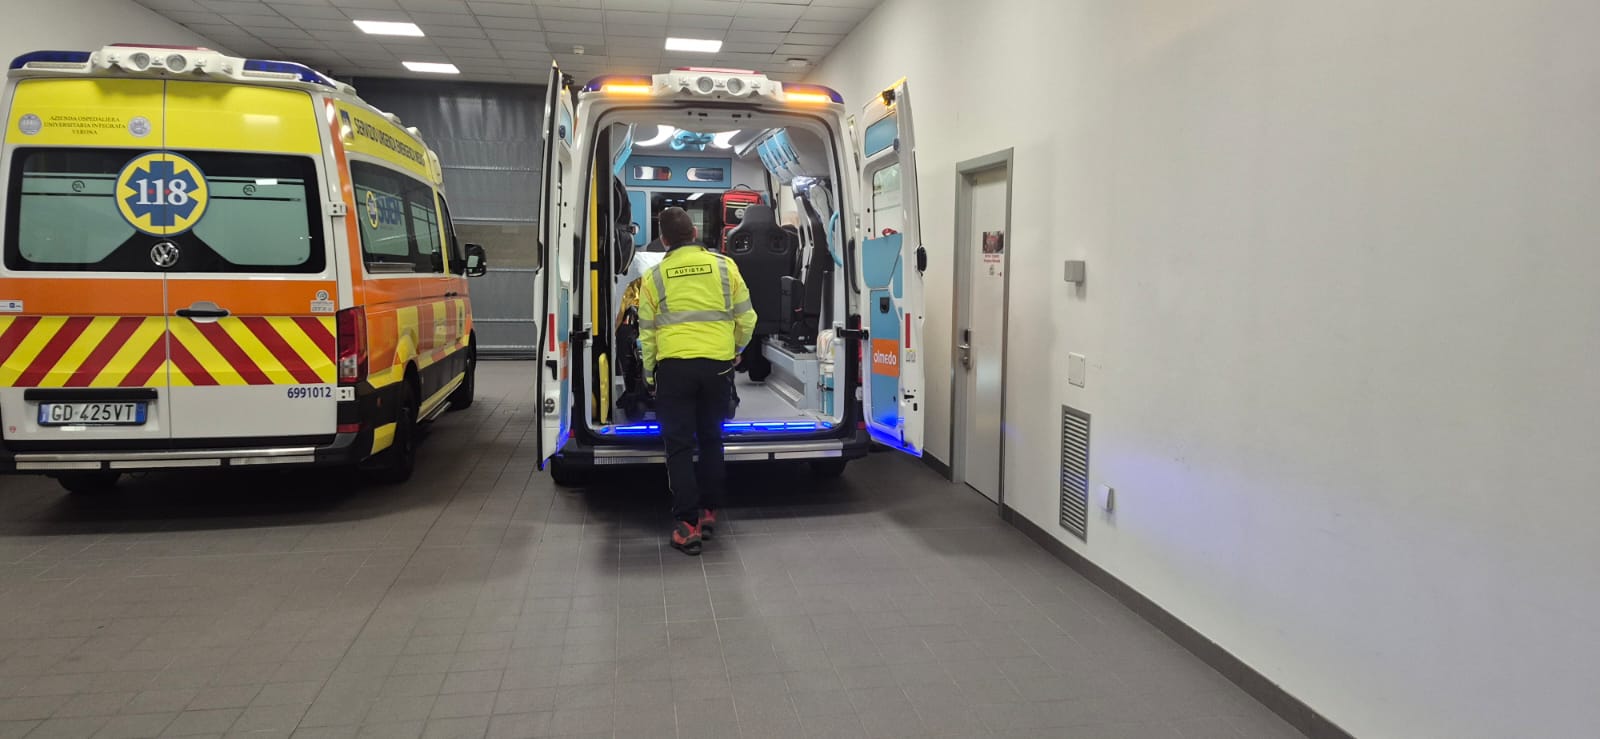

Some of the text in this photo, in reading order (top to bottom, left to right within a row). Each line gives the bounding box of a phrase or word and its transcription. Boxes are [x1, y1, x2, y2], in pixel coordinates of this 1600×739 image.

[354, 117, 378, 142] SERVIZIO
[136, 178, 189, 206] 118
[674, 267, 704, 275] AUTISTA
[873, 349, 897, 366] olmedo
[287, 386, 332, 399] 6991012
[51, 404, 73, 421] GD
[79, 404, 134, 421] 425VT
